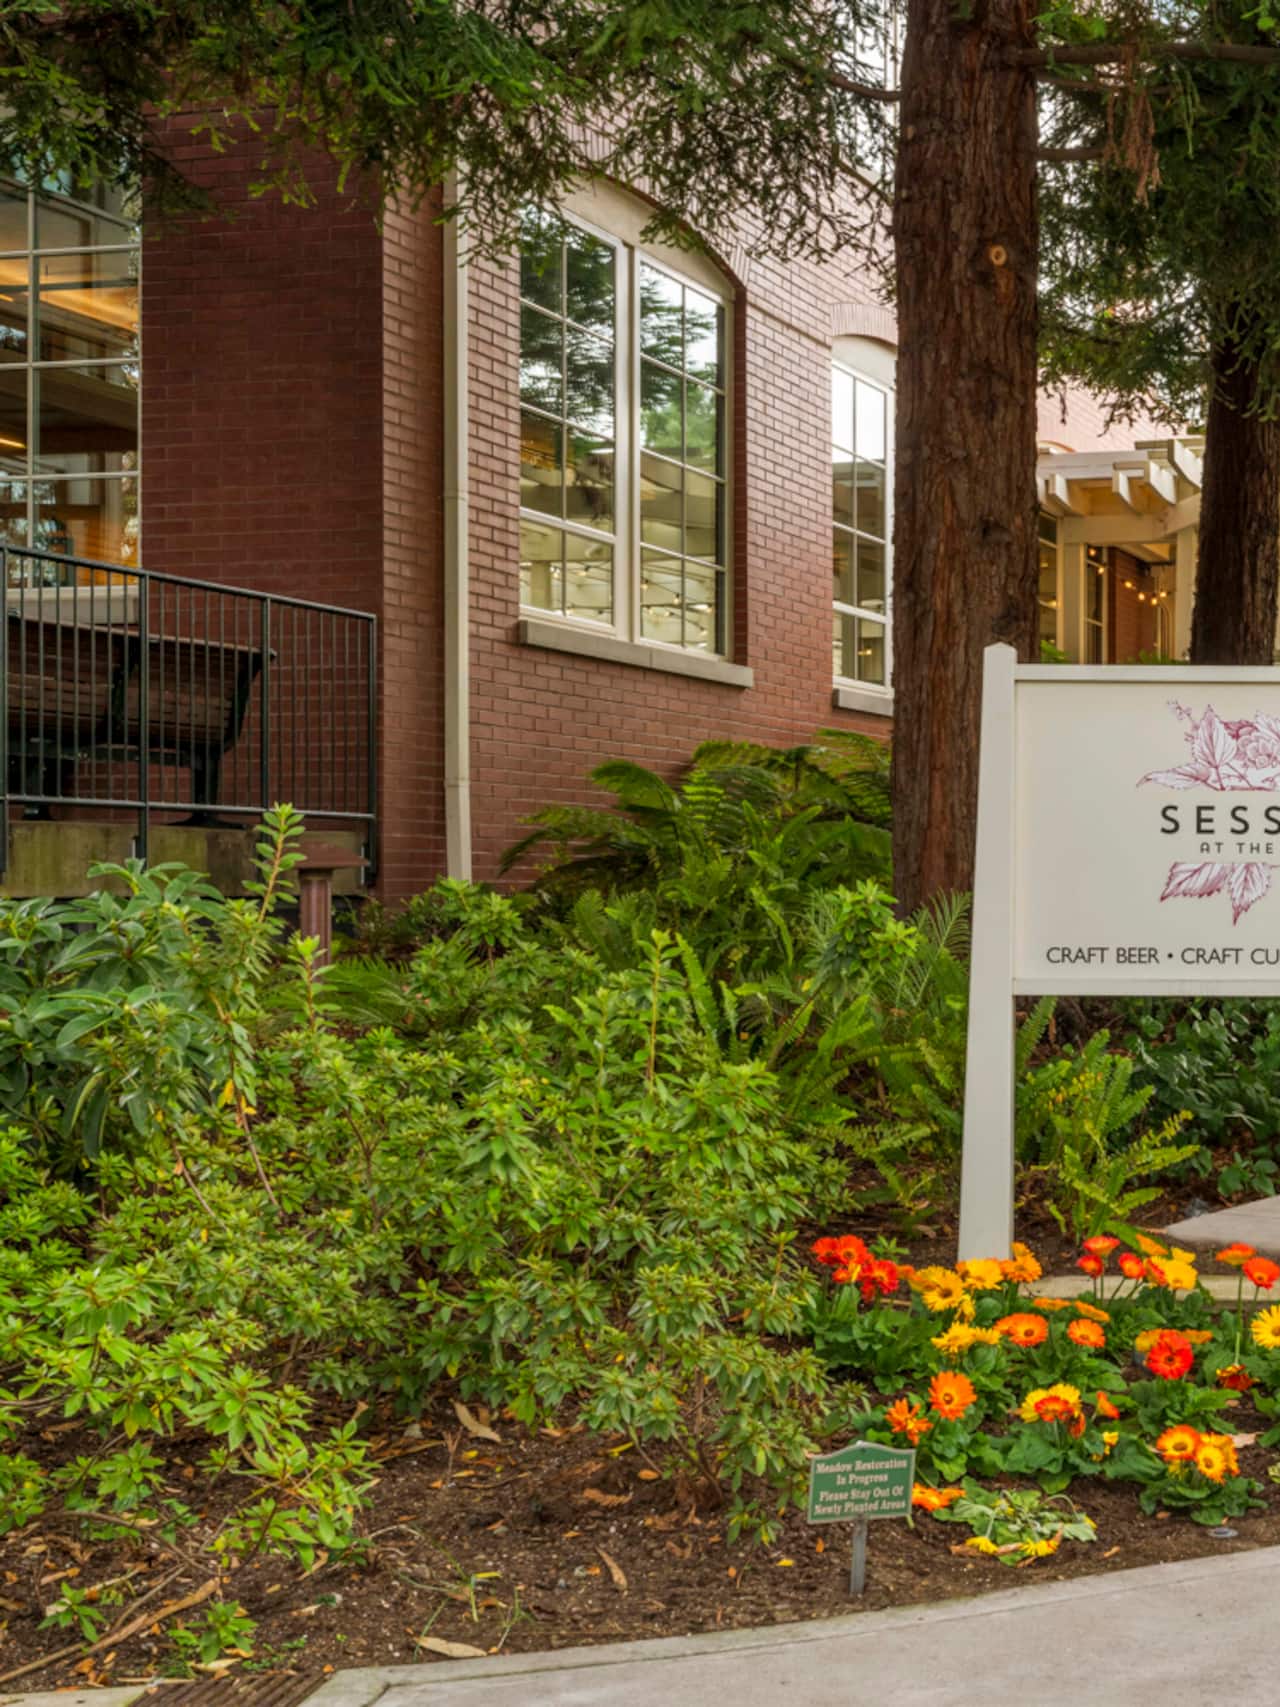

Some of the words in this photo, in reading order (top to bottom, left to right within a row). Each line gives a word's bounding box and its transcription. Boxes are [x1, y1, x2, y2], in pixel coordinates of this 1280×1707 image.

[1199, 842, 1224, 854] AT
[1236, 842, 1273, 855] THE
[1045, 946, 1110, 964] CRAFT
[1115, 947, 1161, 965] BEER
[1180, 947, 1244, 965] CRAFT
[815, 1462, 852, 1473] Meadow
[854, 1458, 908, 1471] Restoration
[836, 1474, 846, 1485] In
[848, 1473, 889, 1485] Progress
[819, 1490, 848, 1501] Please
[850, 1488, 871, 1499] Stay
[873, 1486, 890, 1497] Out
[892, 1485, 904, 1496] Of
[814, 1504, 841, 1515] Newly
[844, 1501, 879, 1512] Planted
[880, 1499, 906, 1510] Areas
